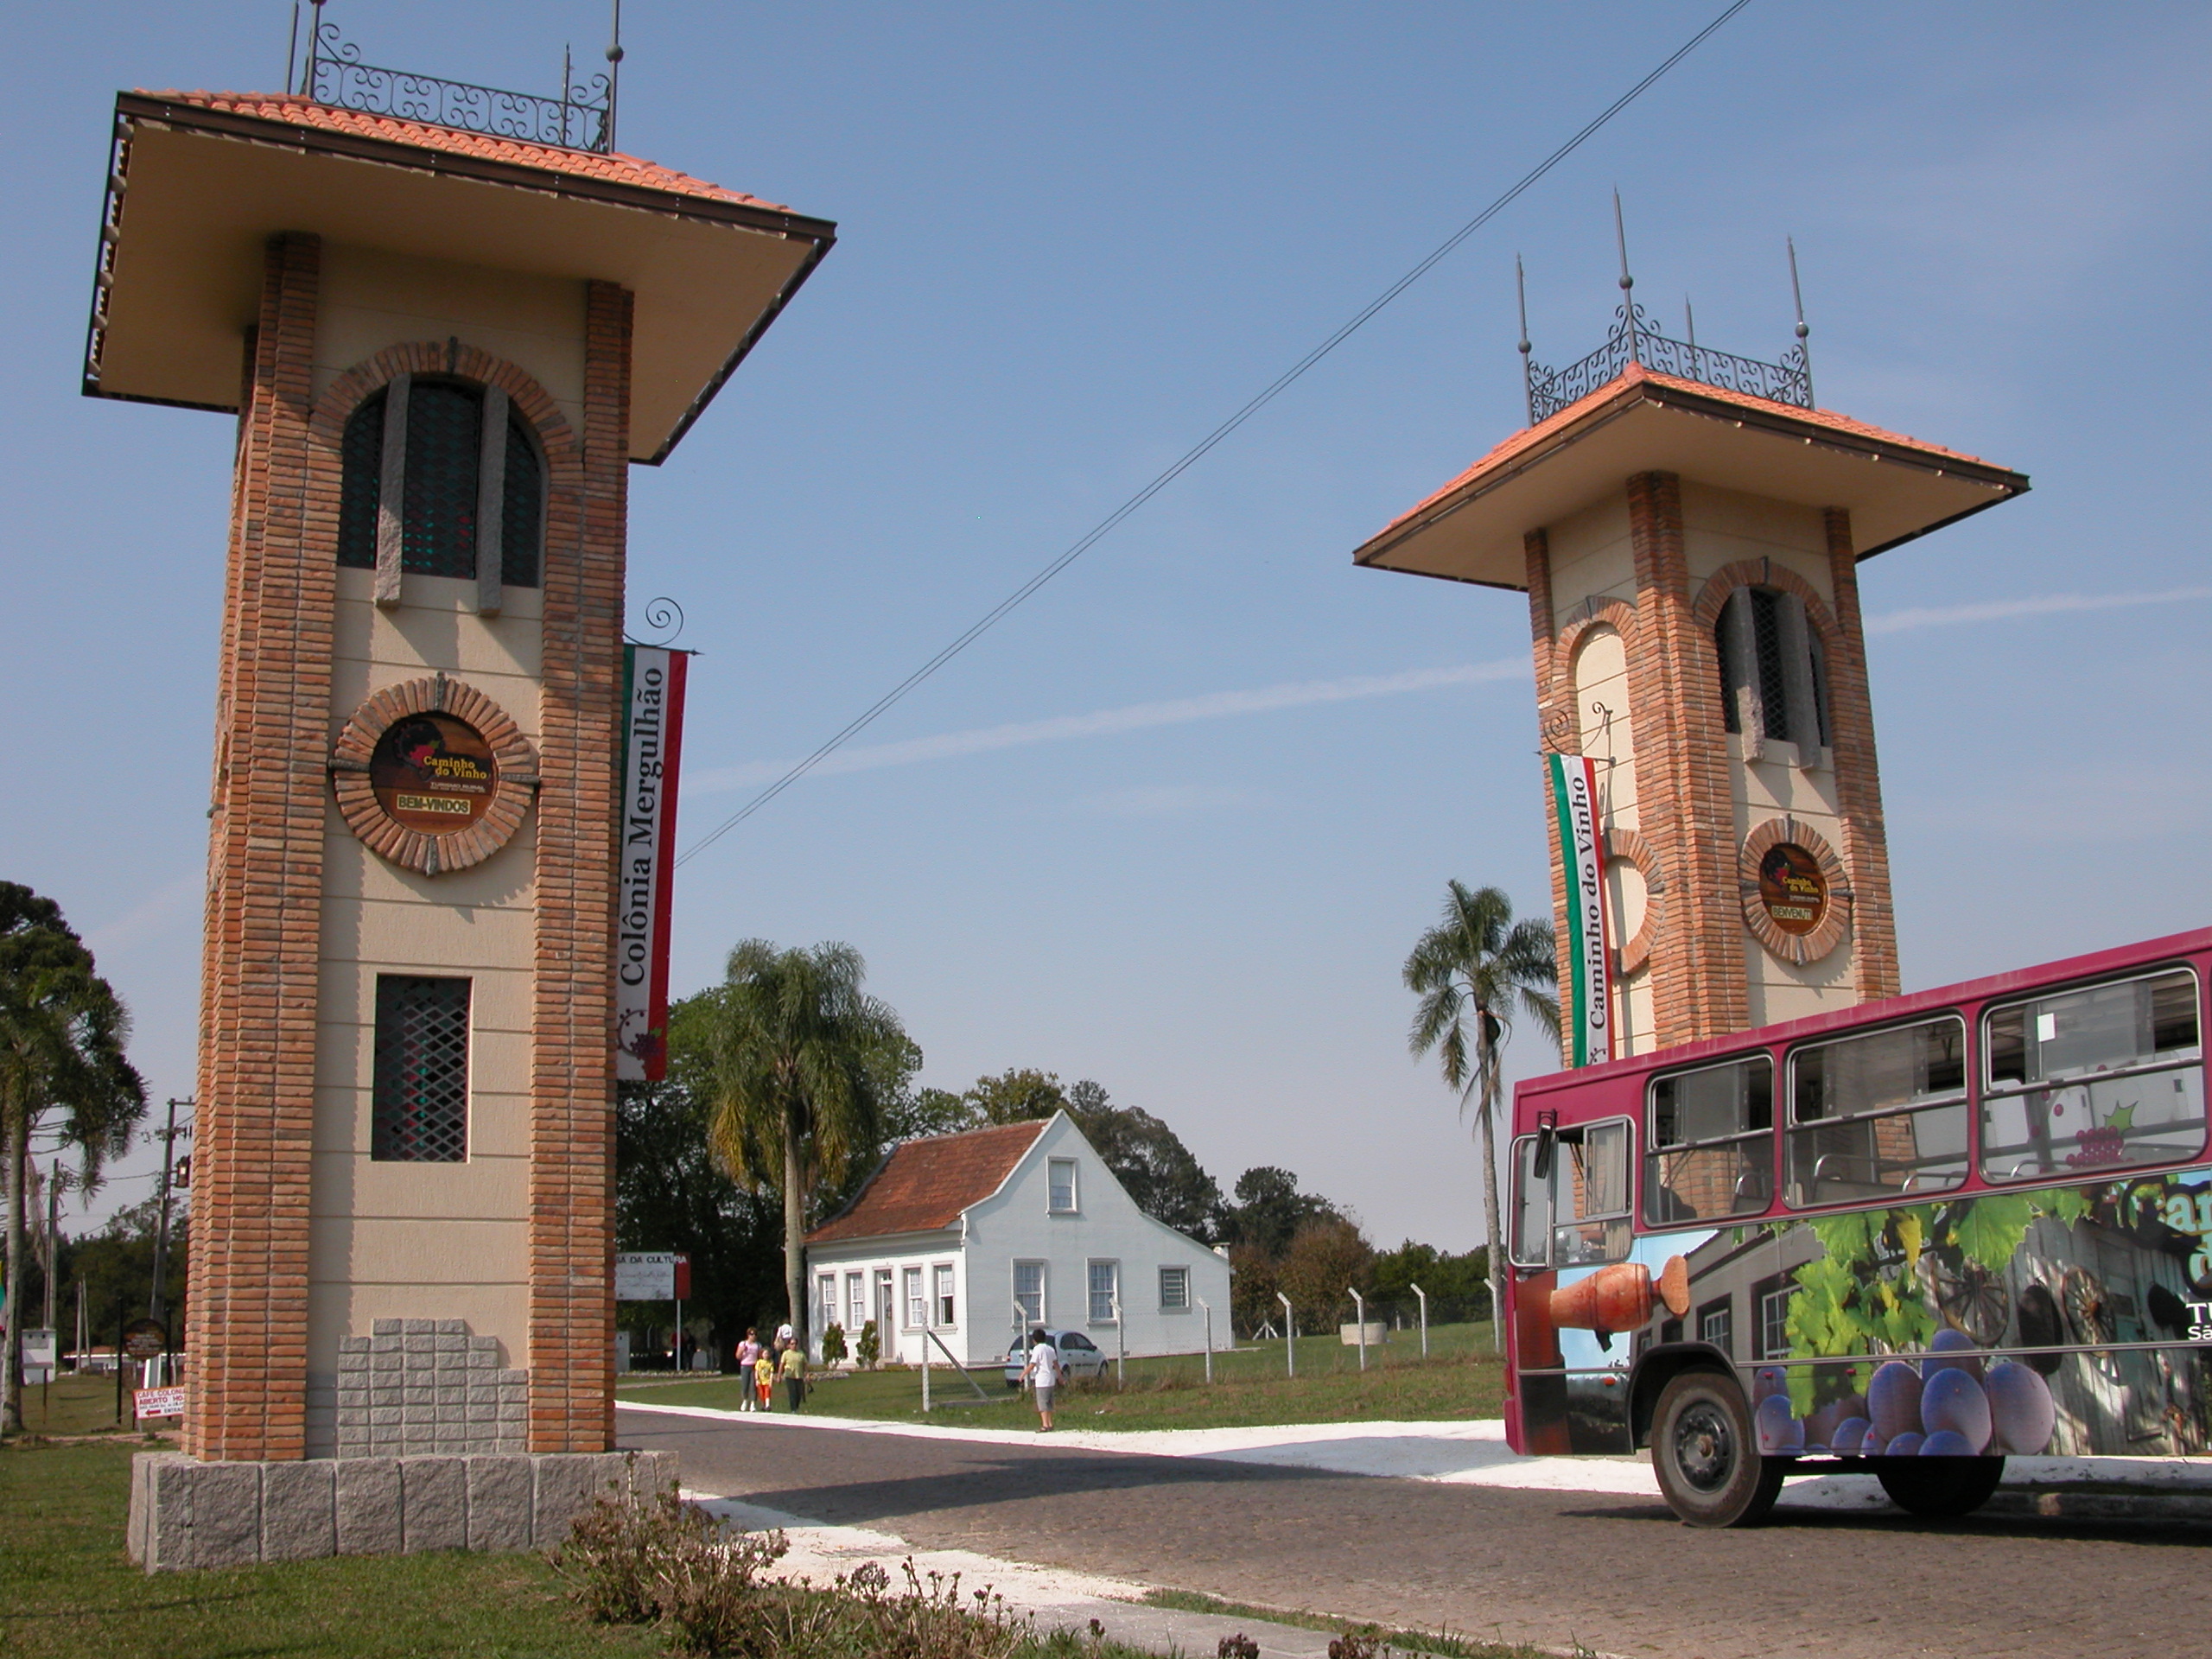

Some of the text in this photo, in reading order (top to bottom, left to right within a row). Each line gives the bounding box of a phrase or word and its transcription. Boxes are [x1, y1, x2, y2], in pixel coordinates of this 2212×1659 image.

[423, 755, 475, 769] Caminho
[435, 766, 487, 779] do Vinho
[398, 797, 469, 813] BEM-VINDOS
[620, 668, 665, 986] Colônia Mergulhão
[1573, 777, 1605, 1030] Caminho do Vinho
[646, 1255, 687, 1264] CULTURA
[2188, 1325, 2212, 1341] Sã
